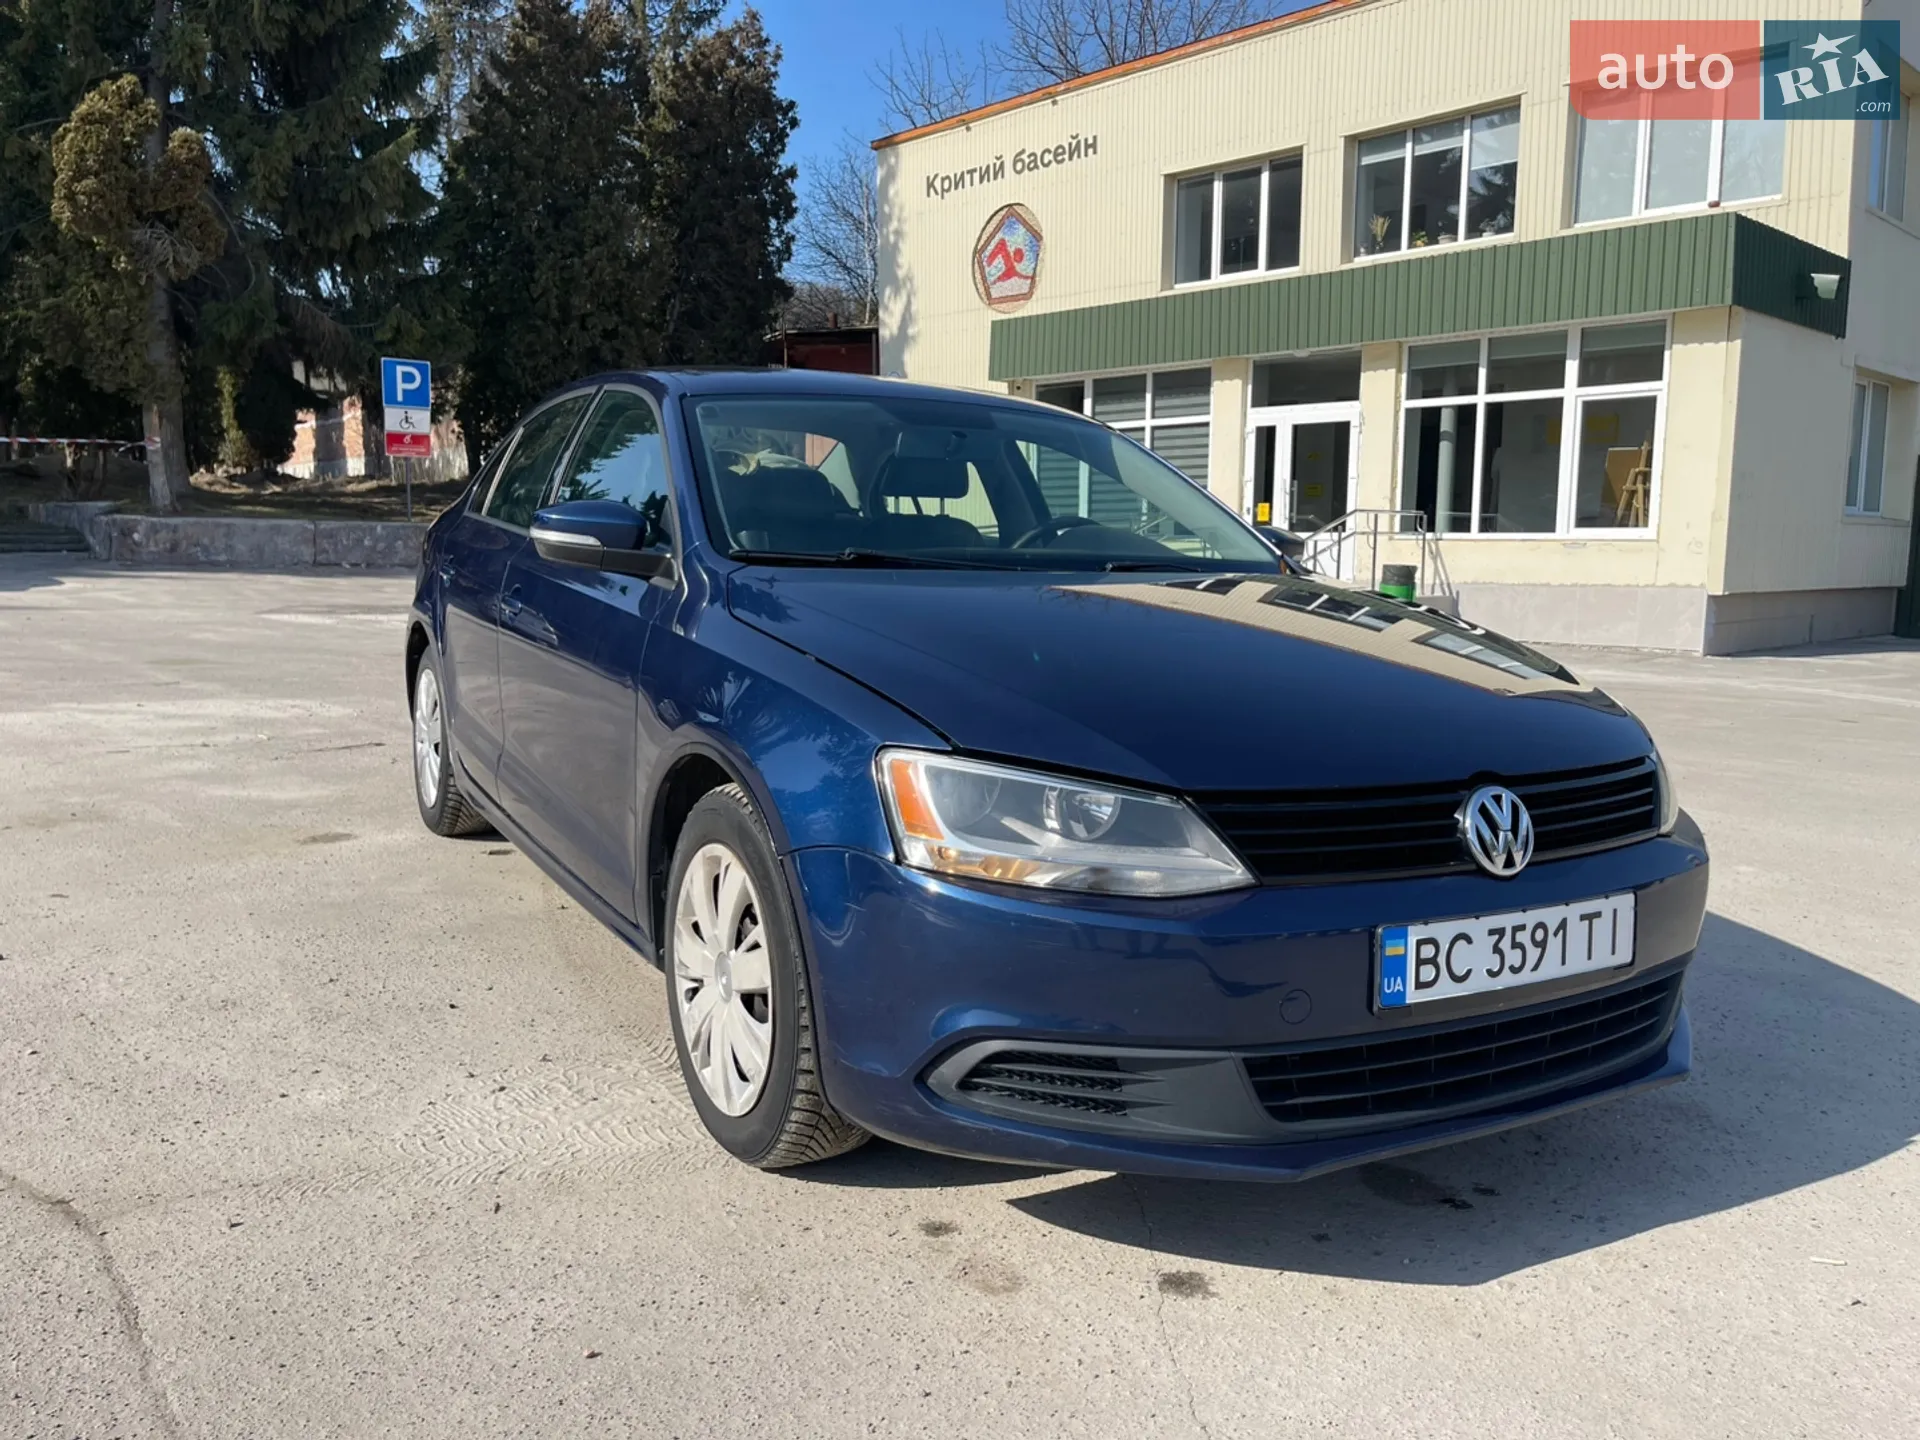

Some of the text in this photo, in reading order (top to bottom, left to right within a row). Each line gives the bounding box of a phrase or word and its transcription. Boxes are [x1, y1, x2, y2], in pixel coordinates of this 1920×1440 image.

[926, 133, 1098, 200] Критий басейн
[396, 365, 421, 402] P
[1413, 908, 1618, 991] BC 3591 TI
[1383, 976, 1404, 994] UA
